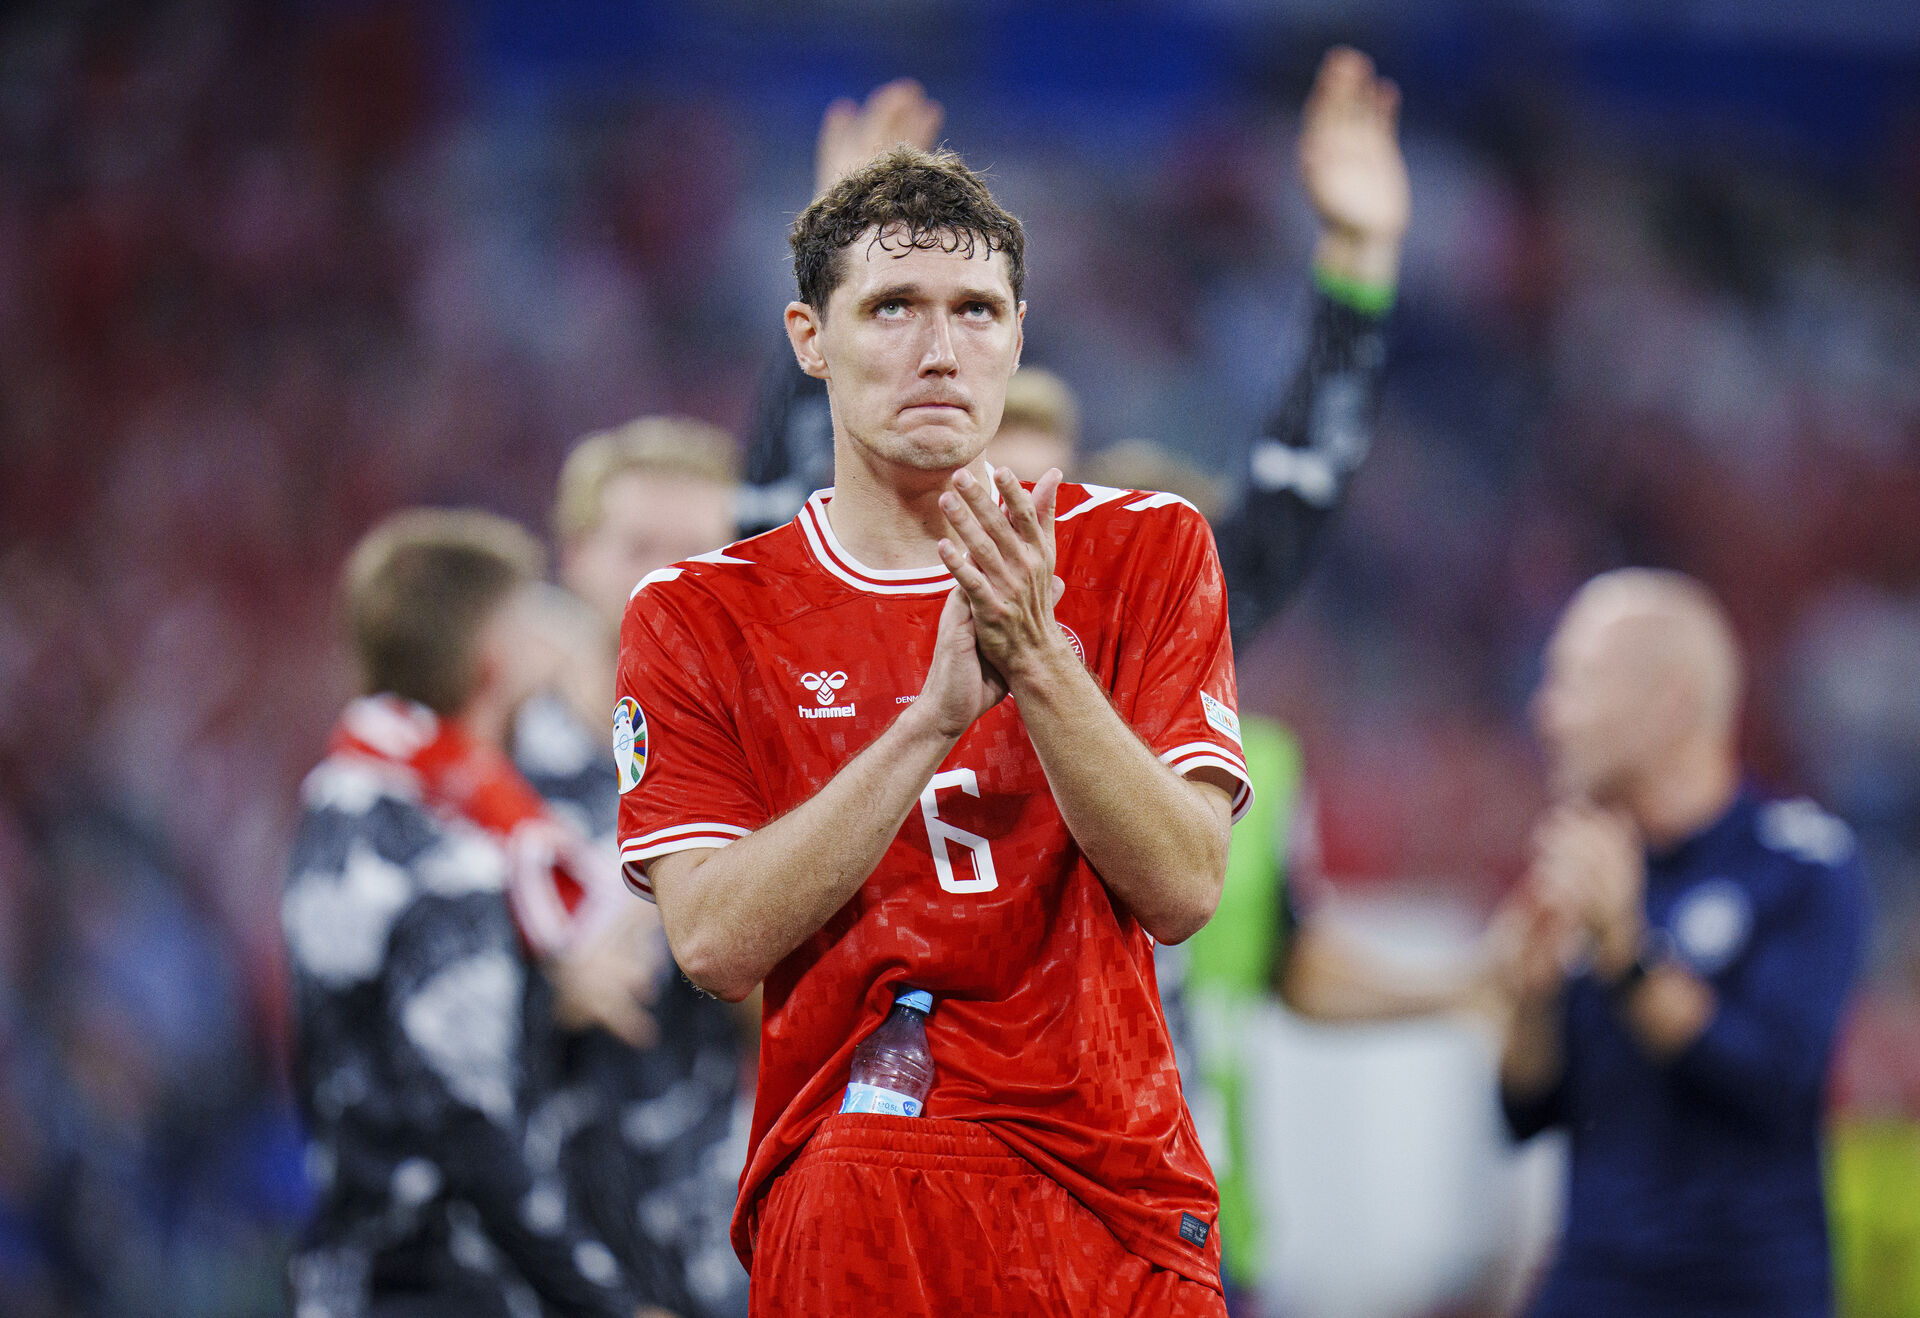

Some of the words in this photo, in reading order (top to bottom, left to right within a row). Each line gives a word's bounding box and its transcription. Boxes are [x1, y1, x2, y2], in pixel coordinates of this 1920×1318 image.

[896, 695, 919, 704] DENM
[798, 703, 856, 719] hummel
[920, 768, 999, 894] 6
